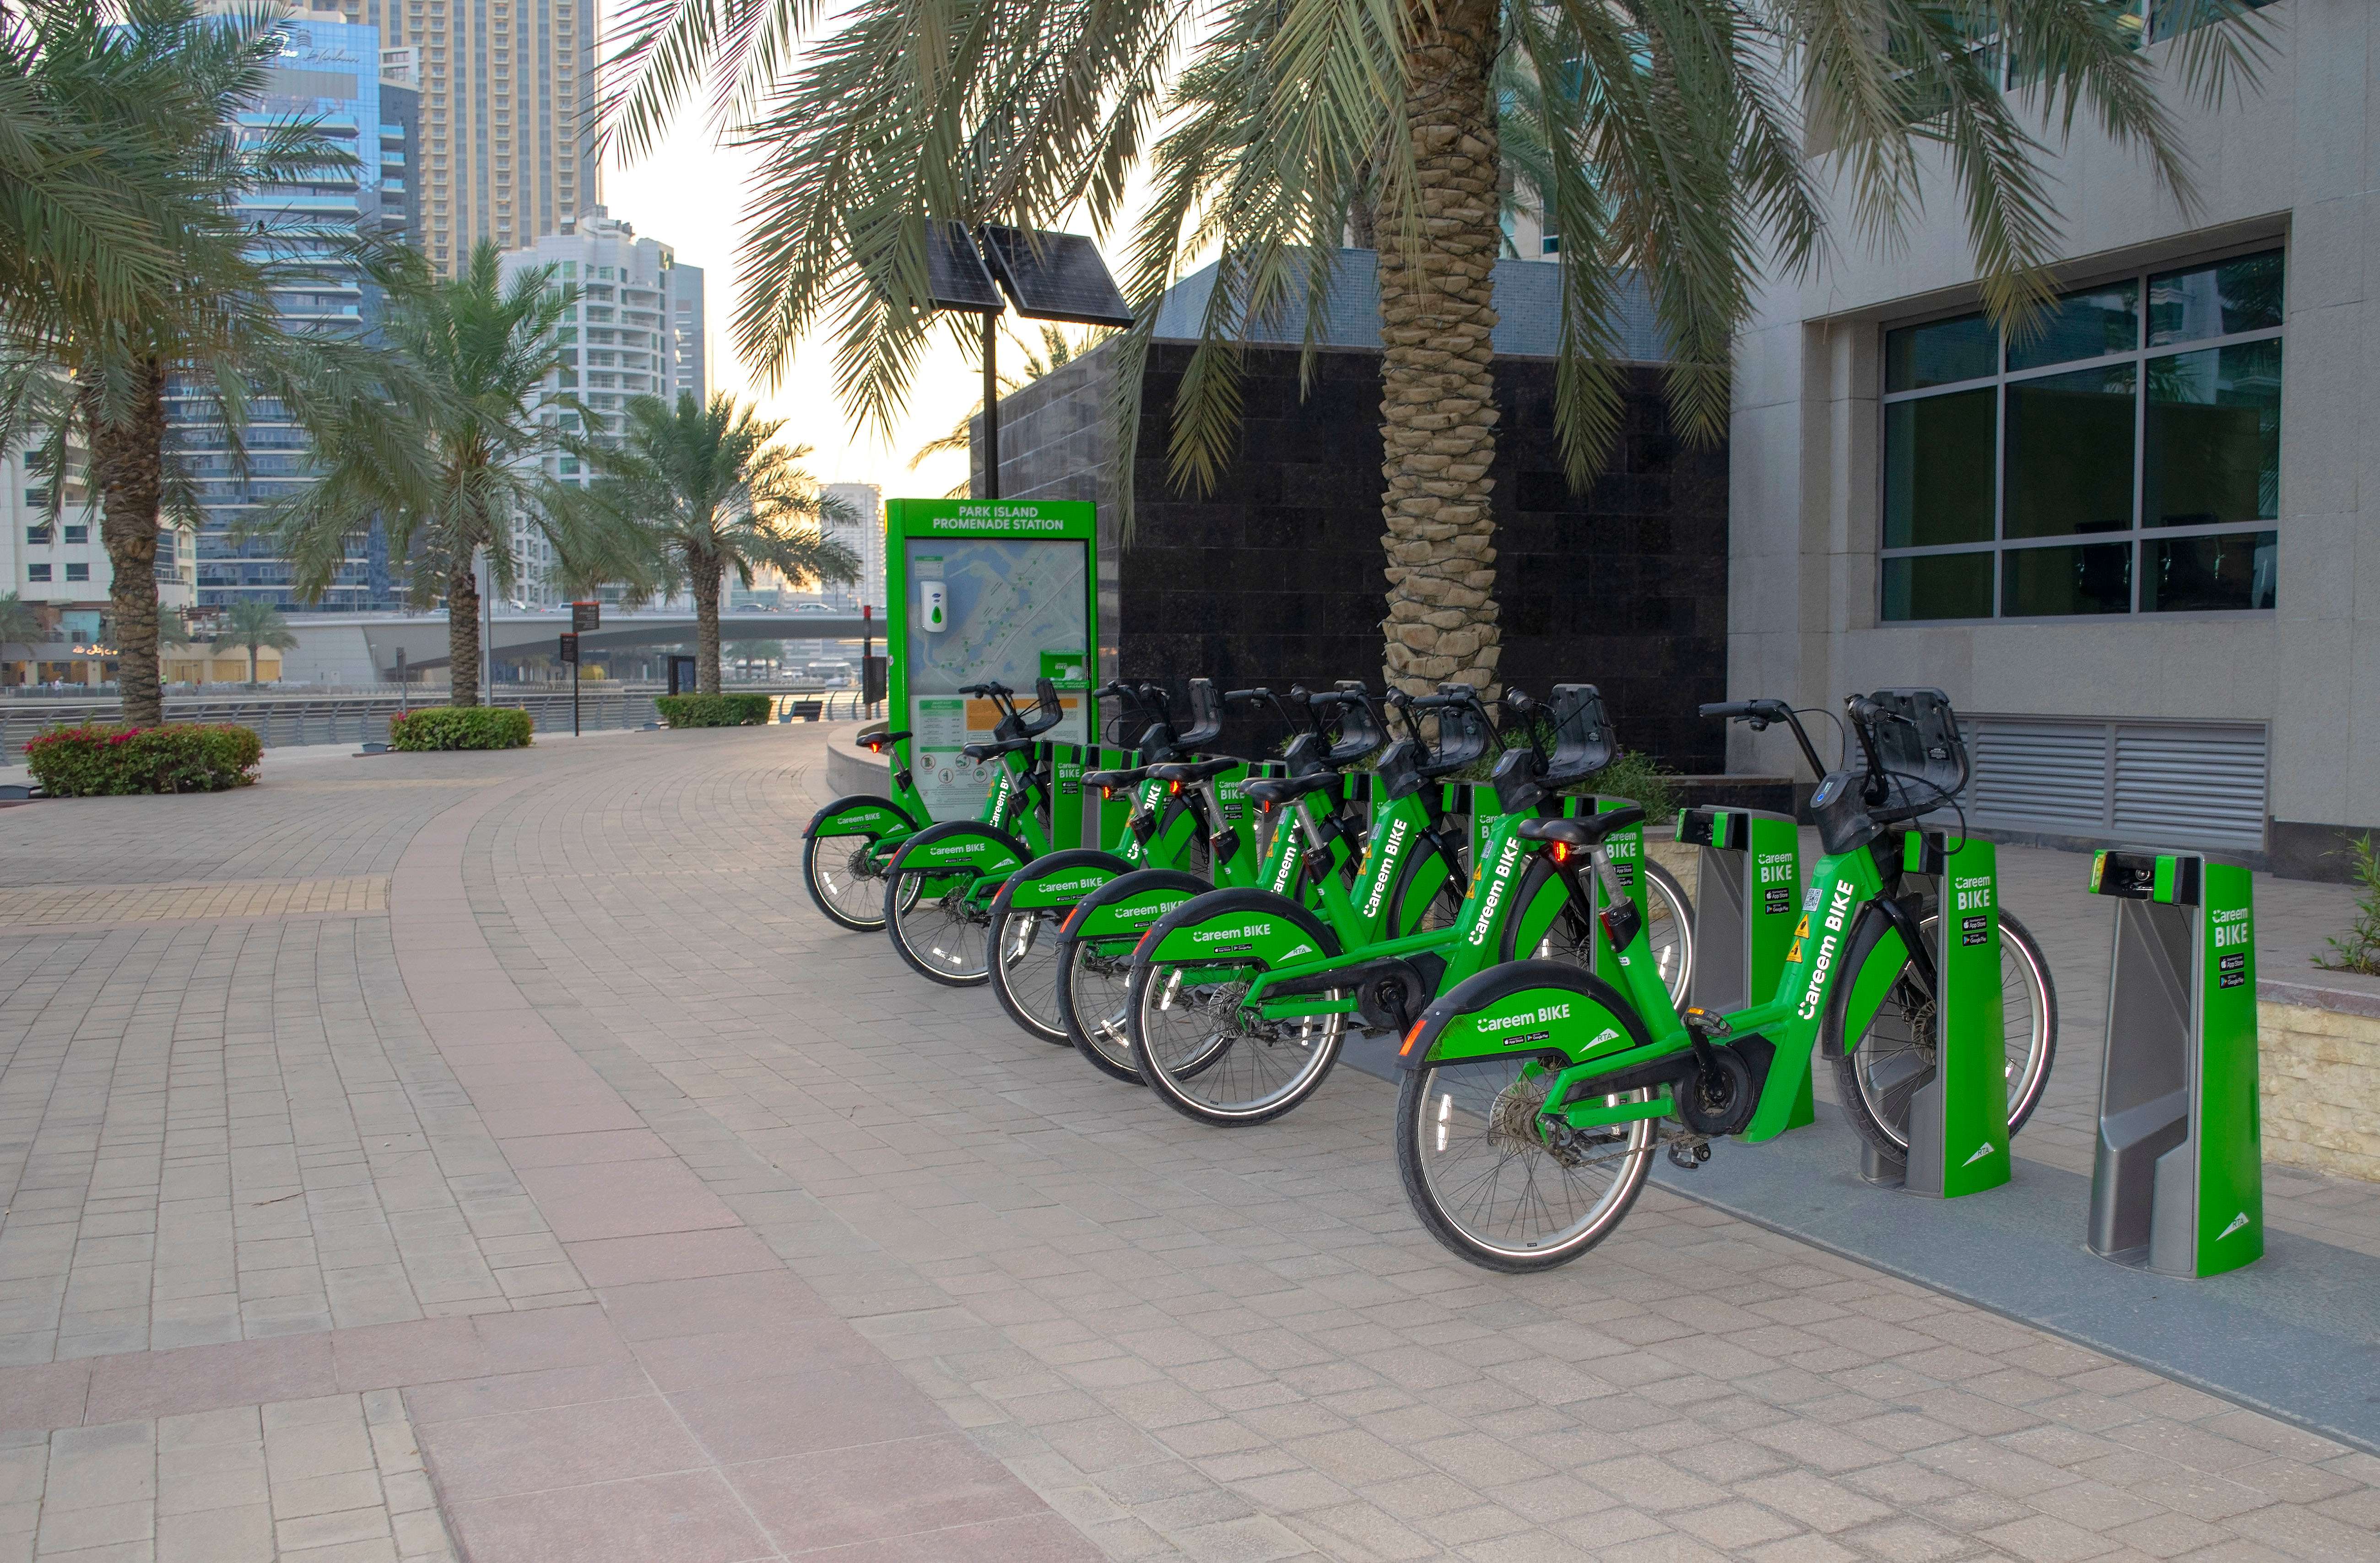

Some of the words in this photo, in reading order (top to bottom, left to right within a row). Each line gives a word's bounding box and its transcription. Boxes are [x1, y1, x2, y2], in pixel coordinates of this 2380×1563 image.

[959, 506, 990, 517] PARK
[994, 506, 1039, 518] ISLAND
[933, 519, 1010, 530] PROMENADE
[1012, 519, 1064, 530] STATION
[1059, 769, 1080, 778] BIKE
[1144, 783, 1162, 811] BIKE
[1220, 789, 1245, 800] BIKE
[989, 790, 1006, 827] Careem
[837, 816, 865, 825] Careem
[865, 812, 881, 821] BIKE
[1479, 815, 1498, 824] Care
[1385, 819, 1407, 856] BIKE
[930, 846, 964, 855] Careem
[965, 843, 985, 852] BIKE
[1606, 842, 1636, 858] BIKE
[1495, 837, 1521, 878] BIKE
[1758, 853, 1792, 865] Careem
[1270, 847, 1297, 894] areem
[1760, 867, 1792, 883] BIKE
[1039, 882, 1078, 893] Careem
[1080, 876, 1103, 887] BIKE
[1363, 858, 1394, 918] Careem
[1955, 876, 1991, 889] Careem
[1824, 879, 1854, 932] BIKE
[1957, 890, 1991, 911] BIKE
[1114, 906, 1158, 918] Careem
[1468, 880, 1505, 946] Careem
[2212, 908, 2248, 924] Careem
[1193, 930, 1241, 943] Careem
[1244, 924, 1271, 937] BIKE
[2215, 923, 2248, 947] BIKE
[1797, 935, 1838, 1020] Careem
[1477, 1011, 1536, 1033] Careem
[1538, 1003, 1571, 1023] BIKE
[1597, 1033, 1613, 1042] RTA
[1978, 1147, 1989, 1156] RTA
[2233, 1218, 2244, 1228] RTA
